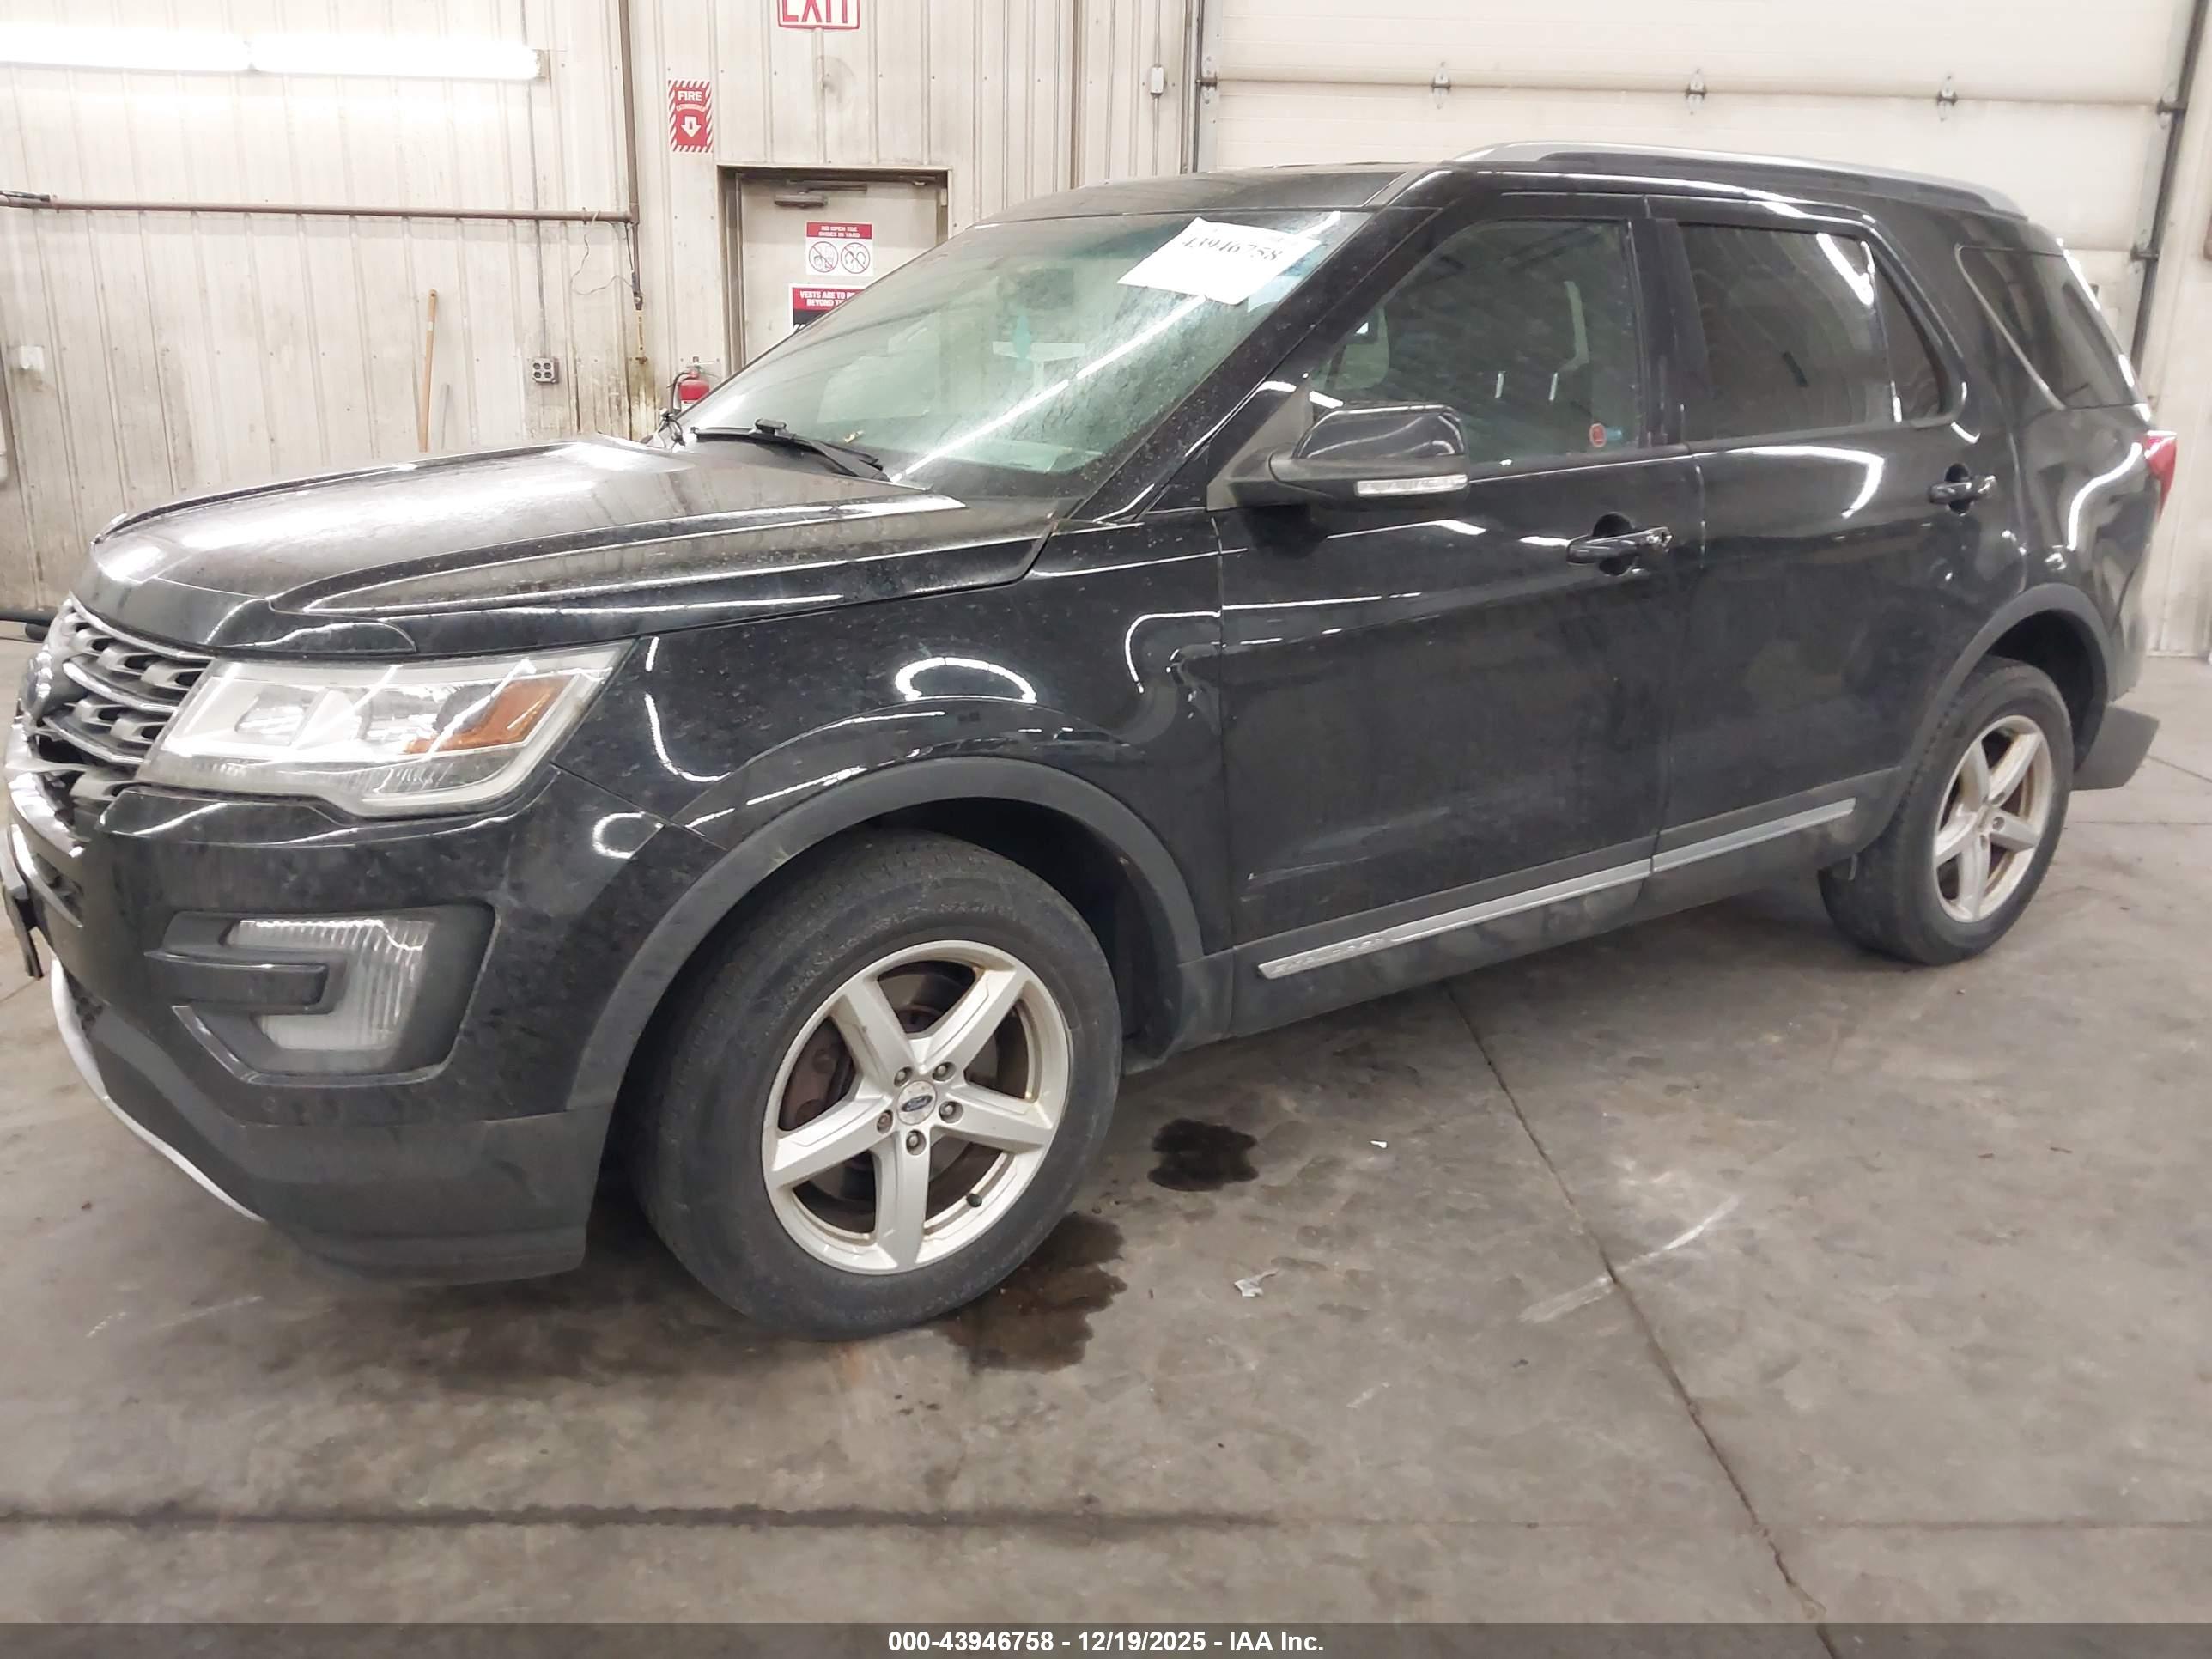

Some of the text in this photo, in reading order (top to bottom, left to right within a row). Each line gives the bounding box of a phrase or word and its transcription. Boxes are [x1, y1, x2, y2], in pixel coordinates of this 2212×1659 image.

[678, 90, 702, 101] FIRE
[800, 290, 821, 299] VESTS
[806, 298, 834, 307] BEYOND
